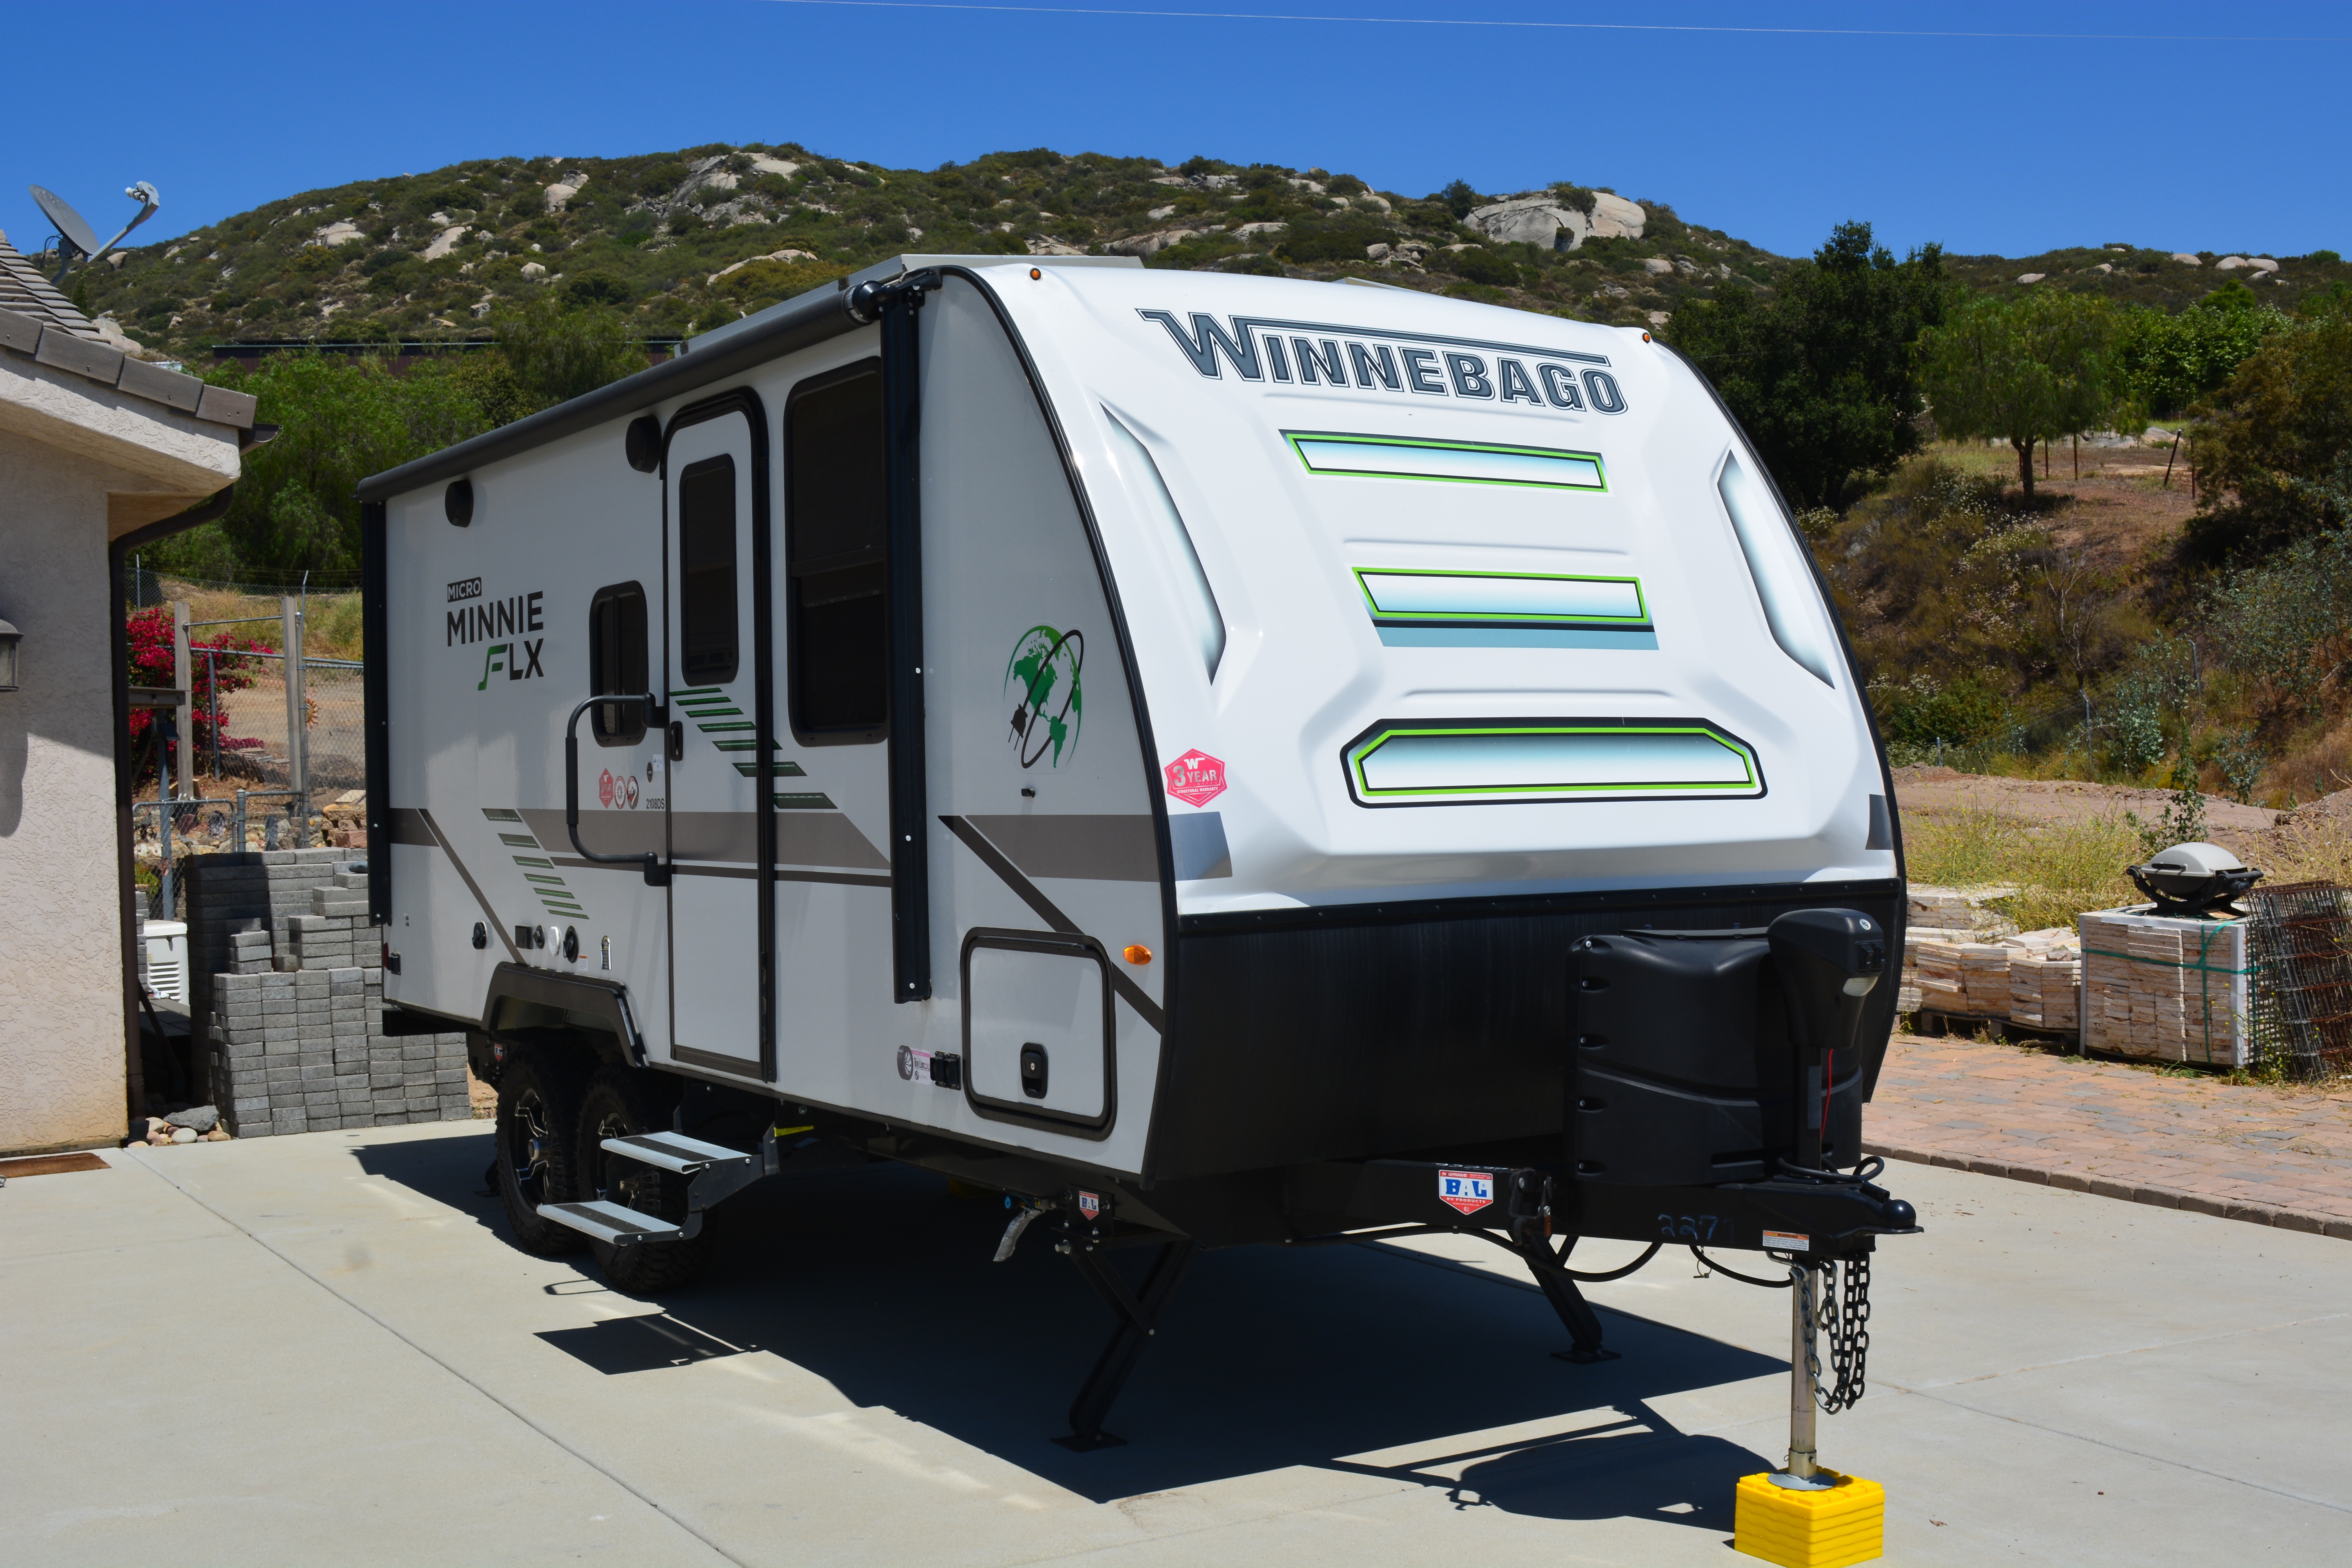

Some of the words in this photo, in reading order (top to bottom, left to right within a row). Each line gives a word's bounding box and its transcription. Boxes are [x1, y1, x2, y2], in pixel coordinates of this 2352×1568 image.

[1134, 308, 1628, 416] WINNEBAGO
[447, 580, 481, 601] MICRO
[447, 591, 544, 647] MINNIE
[477, 638, 544, 691] FLX
[1173, 765, 1186, 787] 3
[1187, 769, 1218, 783] YEAR
[646, 798, 665, 809] 2108DS
[1445, 1178, 1487, 1198] BAL
